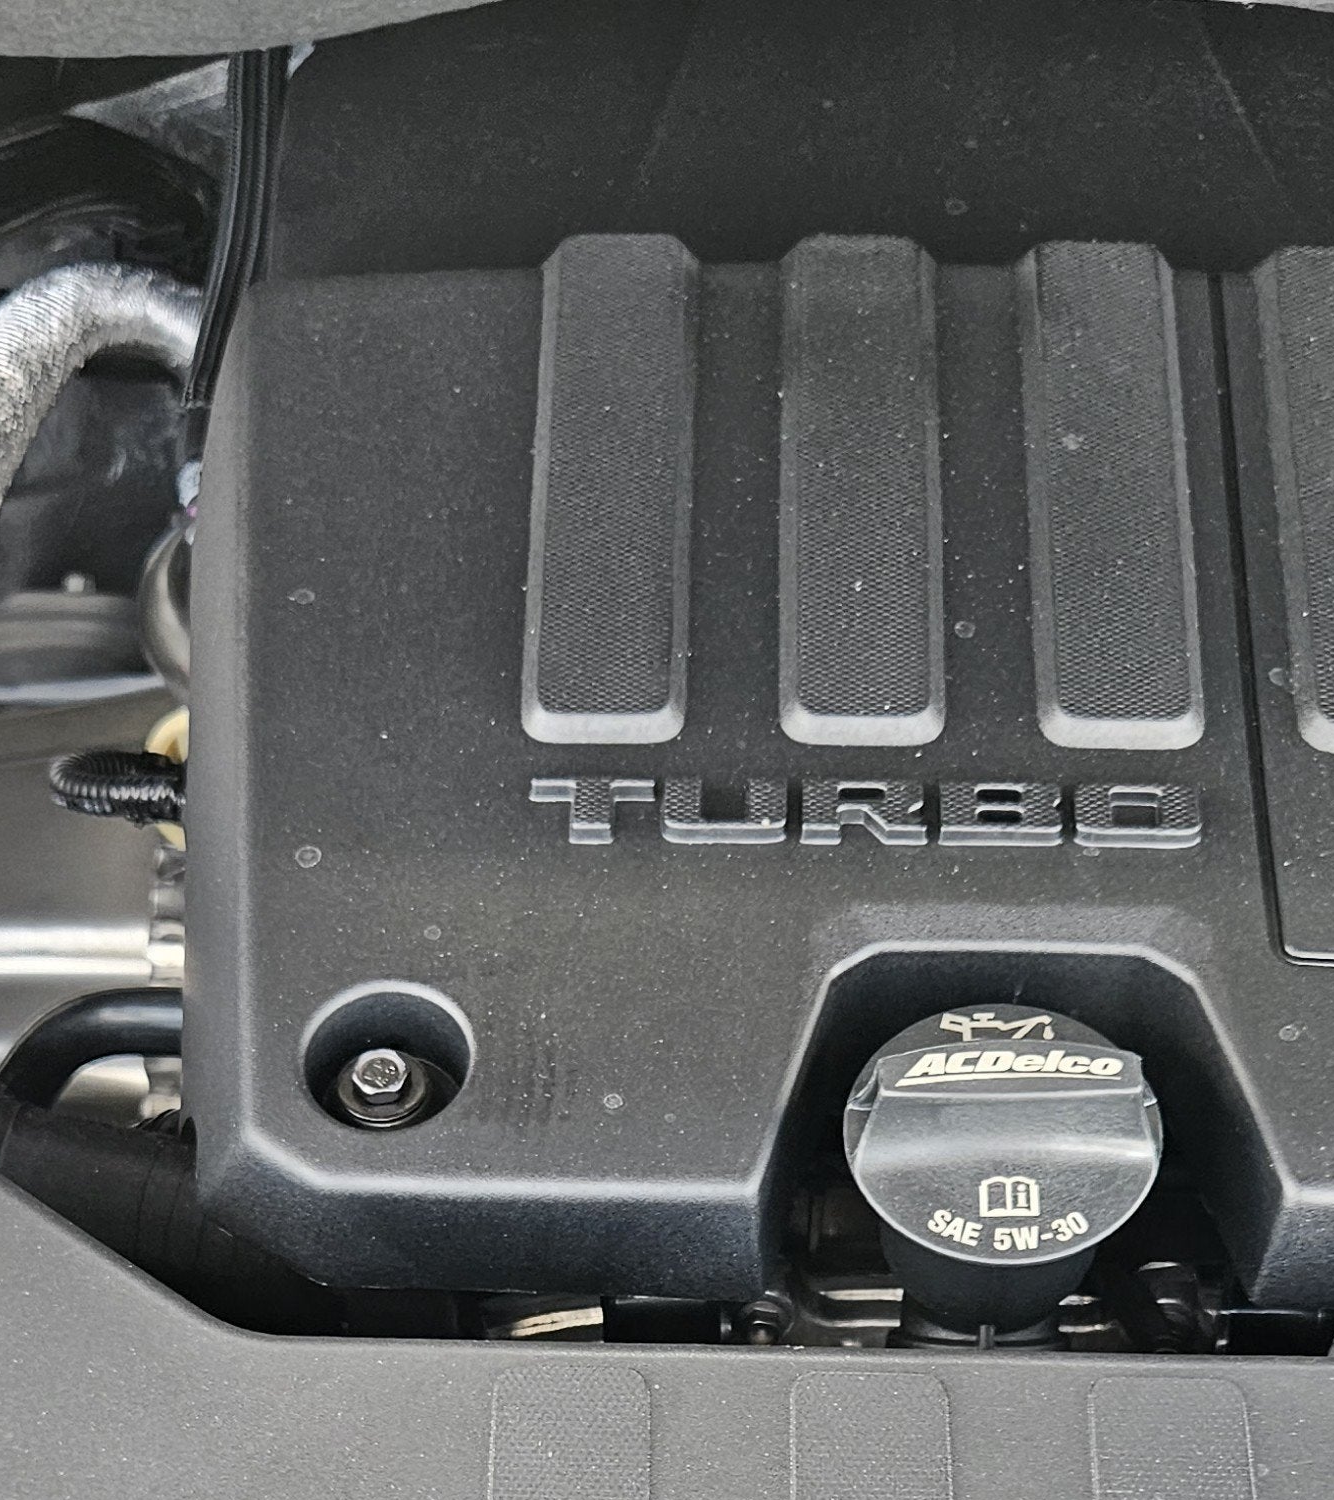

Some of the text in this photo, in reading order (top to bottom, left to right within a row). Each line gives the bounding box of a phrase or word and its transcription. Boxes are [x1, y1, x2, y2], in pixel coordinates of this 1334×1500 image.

[529, 778, 1202, 846] TURBO
[903, 1050, 1124, 1078] ACDelco
[927, 1209, 1090, 1251] SAE 5W-30
